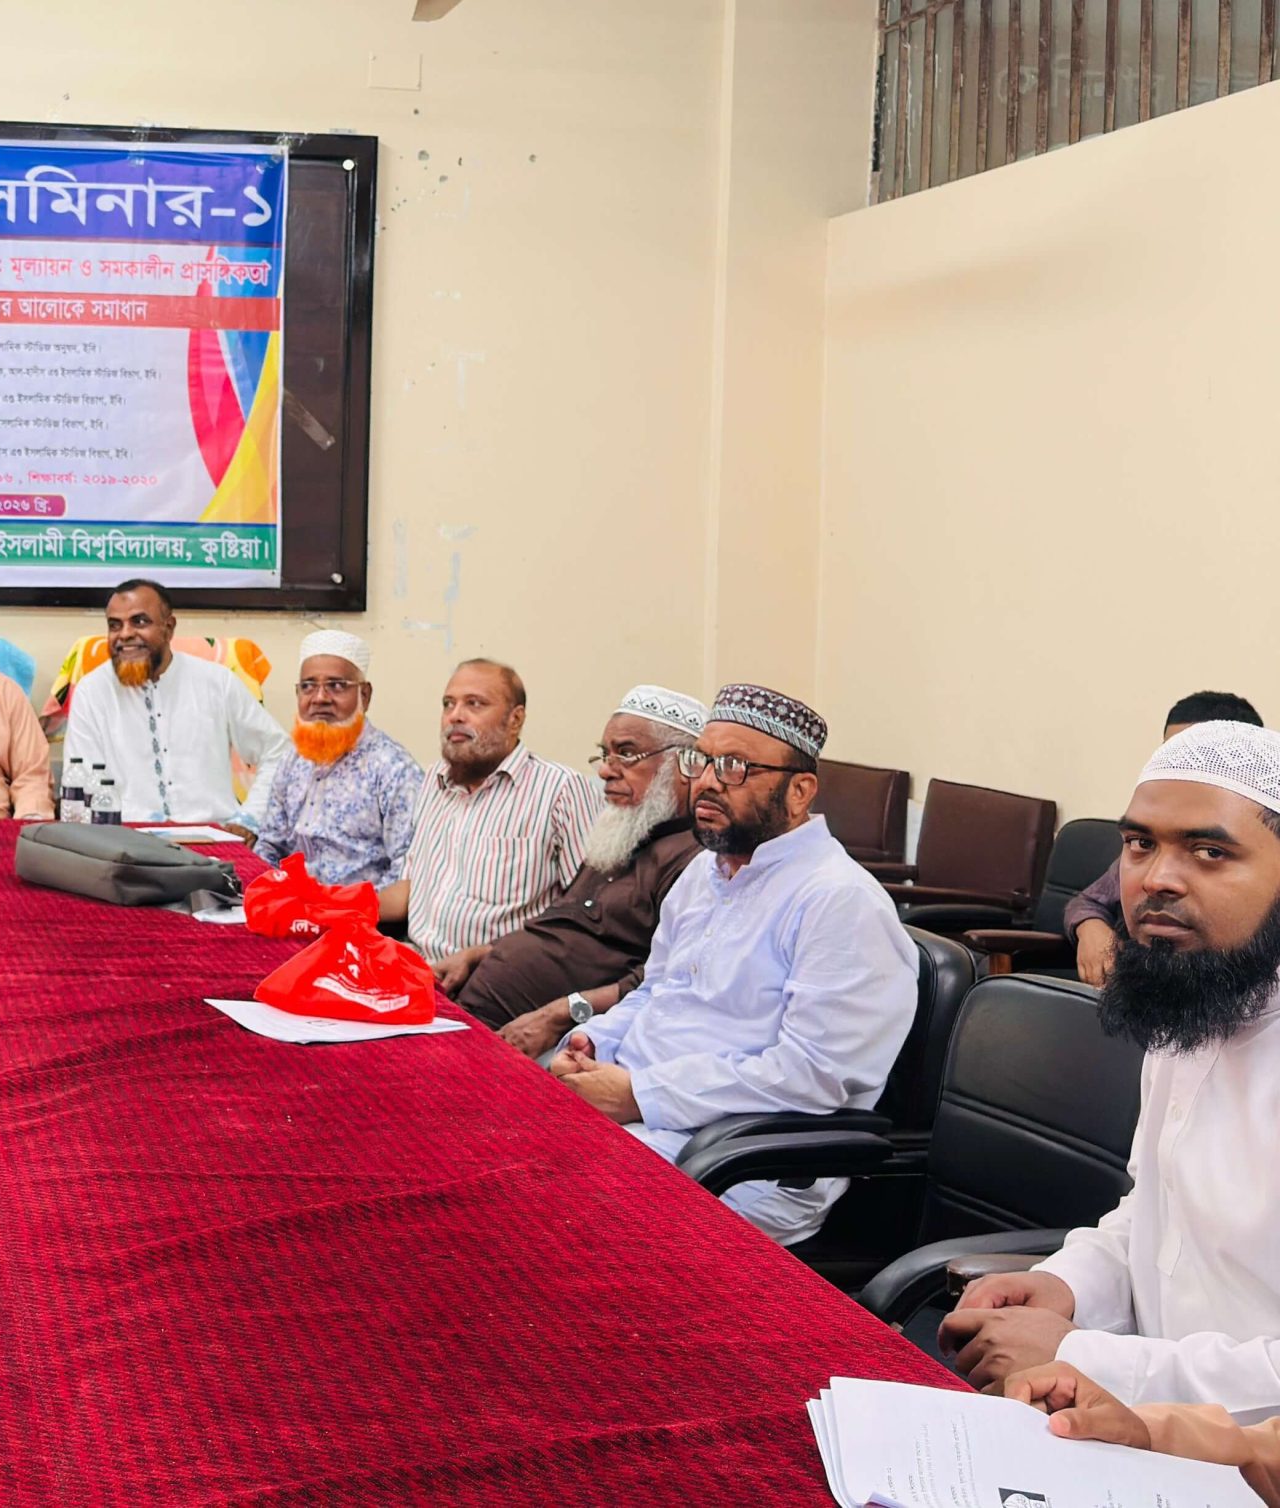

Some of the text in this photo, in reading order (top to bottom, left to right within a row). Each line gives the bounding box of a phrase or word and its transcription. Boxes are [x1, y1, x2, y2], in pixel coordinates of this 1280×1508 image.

[10, 257, 72, 281] মূল্যায়ন
[80, 262, 91, 276] ও
[100, 255, 174, 278] সমকালীন
[180, 256, 270, 286] প্রাসঙ্গিকতা
[18, 298, 85, 320] আলোকে
[91, 299, 148, 321] সমাধান
[68, 529, 193, 562] বিশ্ববিদ্যালয়,
